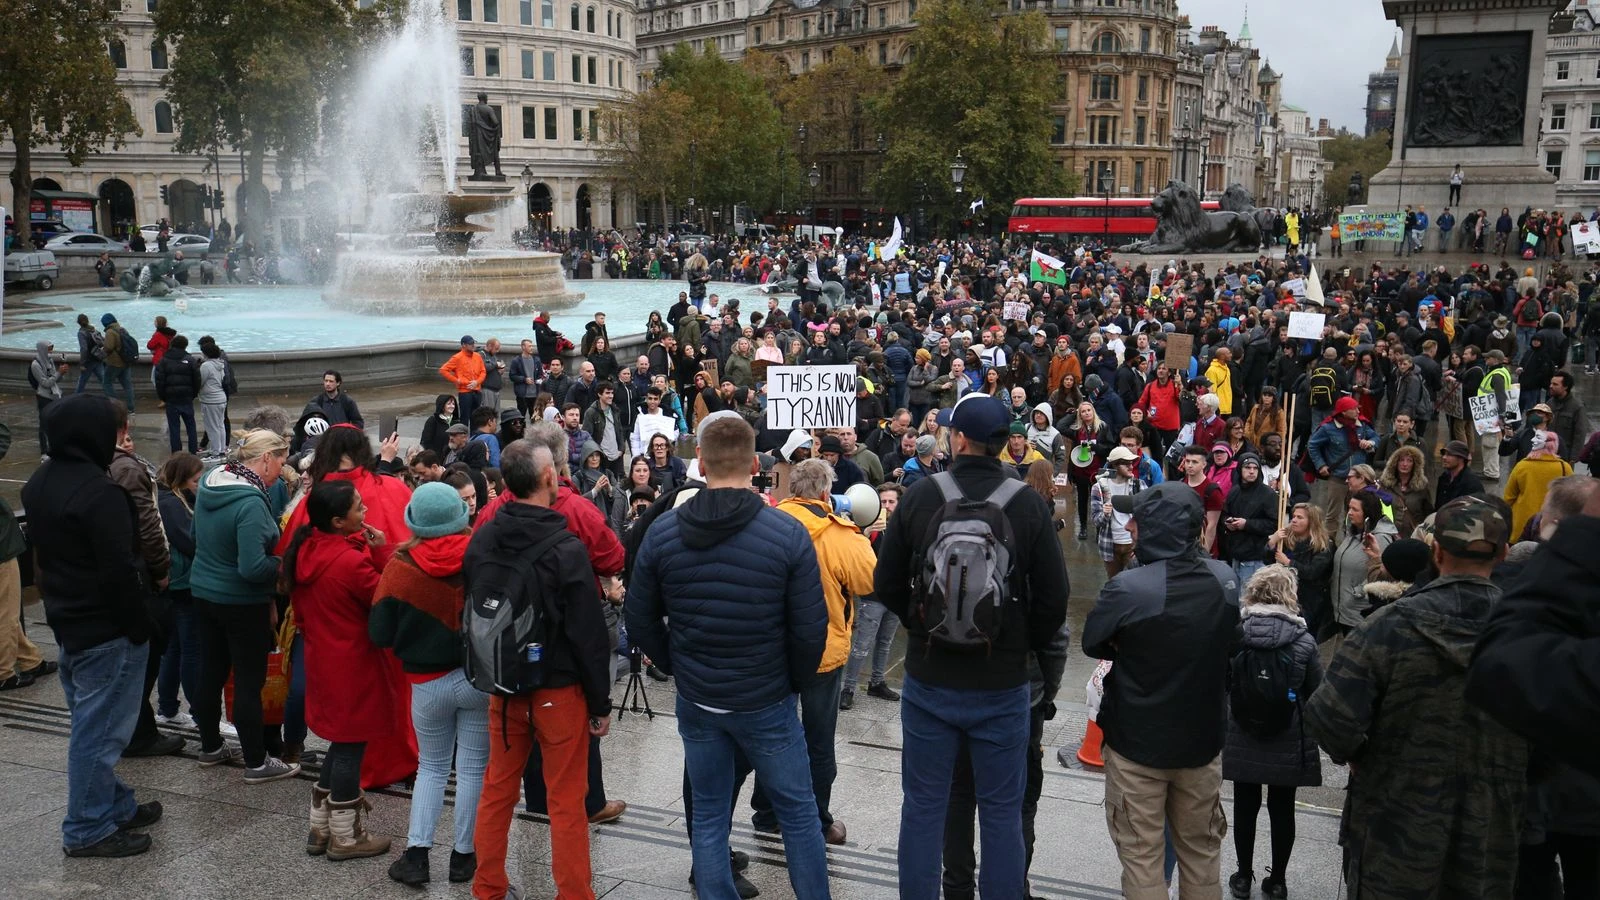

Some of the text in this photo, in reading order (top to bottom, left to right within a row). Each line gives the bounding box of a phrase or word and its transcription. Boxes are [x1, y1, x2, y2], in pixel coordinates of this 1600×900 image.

[1356, 230, 1385, 238] LONDON
[775, 372, 856, 393] THIS IS NOW
[767, 396, 857, 427] TYRANNY
